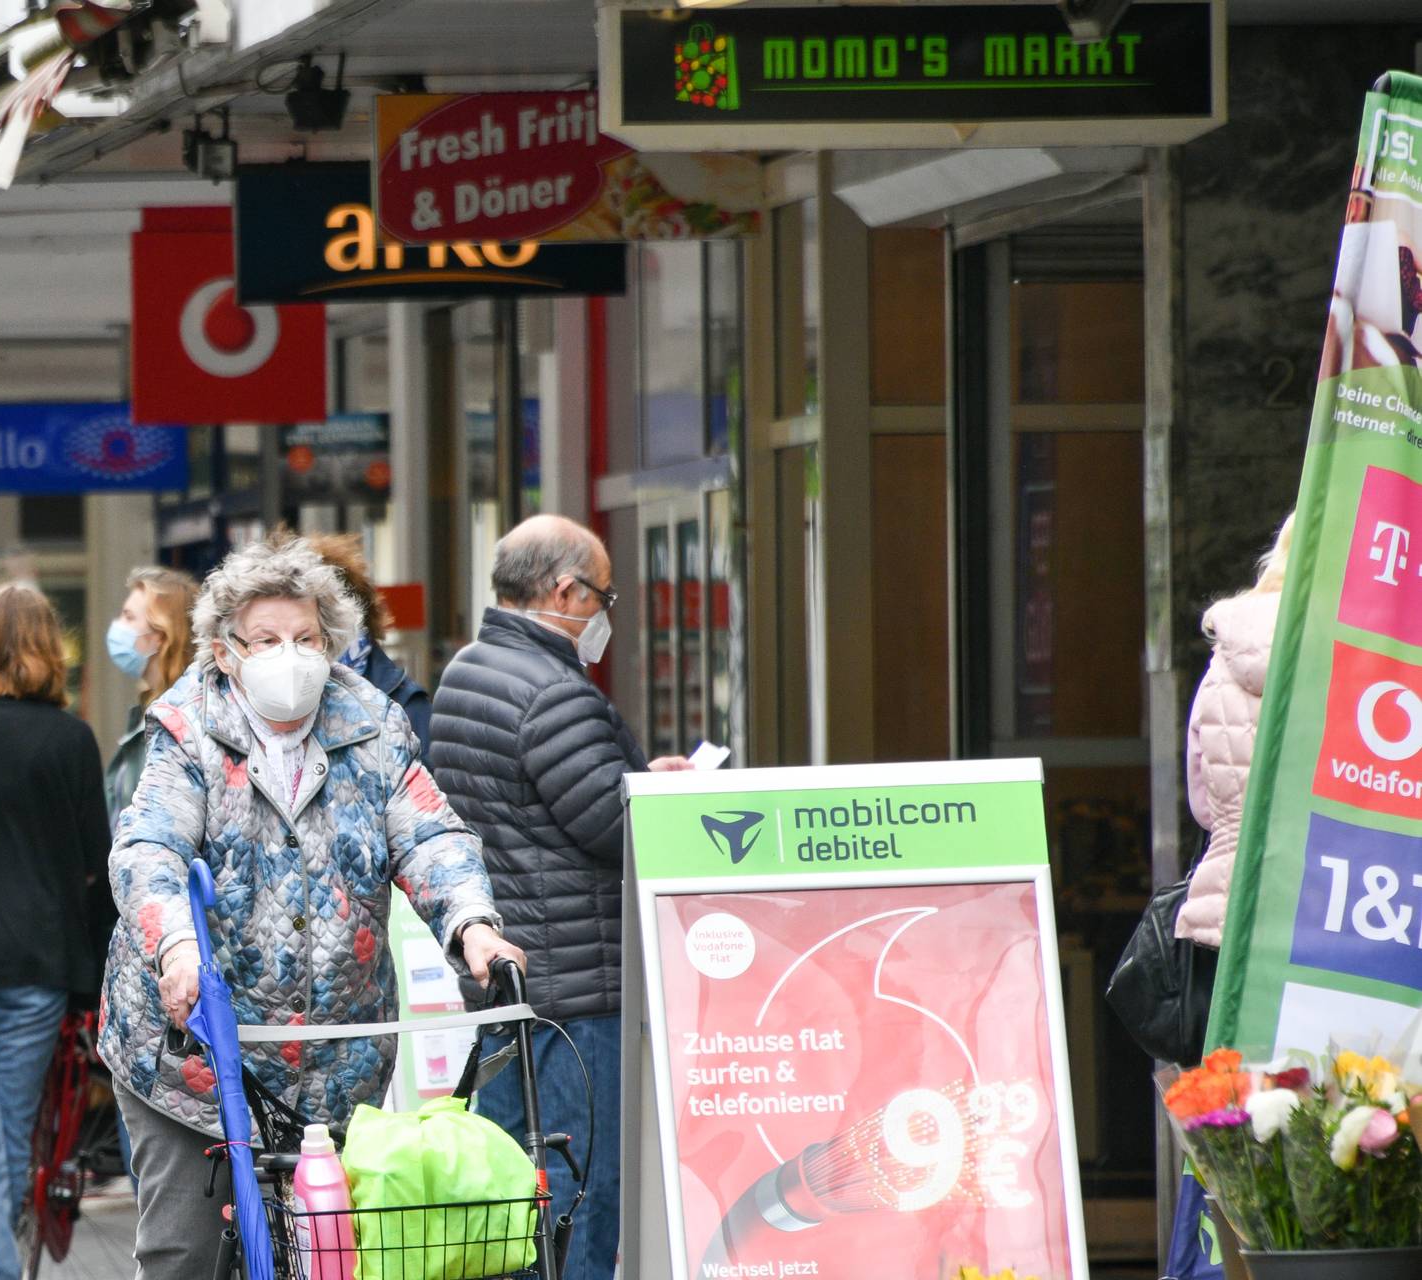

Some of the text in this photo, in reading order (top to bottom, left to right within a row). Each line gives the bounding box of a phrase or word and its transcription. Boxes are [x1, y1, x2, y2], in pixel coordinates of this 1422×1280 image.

[763, 34, 1142, 79] MOMO'S MARKT
[399, 112, 506, 171] Fresh
[411, 175, 574, 231] & Döner
[1337, 383, 1382, 408] Deine
[1334, 405, 1396, 436] Internet
[794, 797, 977, 828] mobilcom
[797, 833, 903, 862] debitel
[694, 929, 744, 939] Inklusive
[682, 1028, 845, 1054] Zuhause flat
[687, 1060, 797, 1085] surfen &
[883, 1088, 964, 1212] 9
[702, 1260, 819, 1279] Wechsel jetzt
